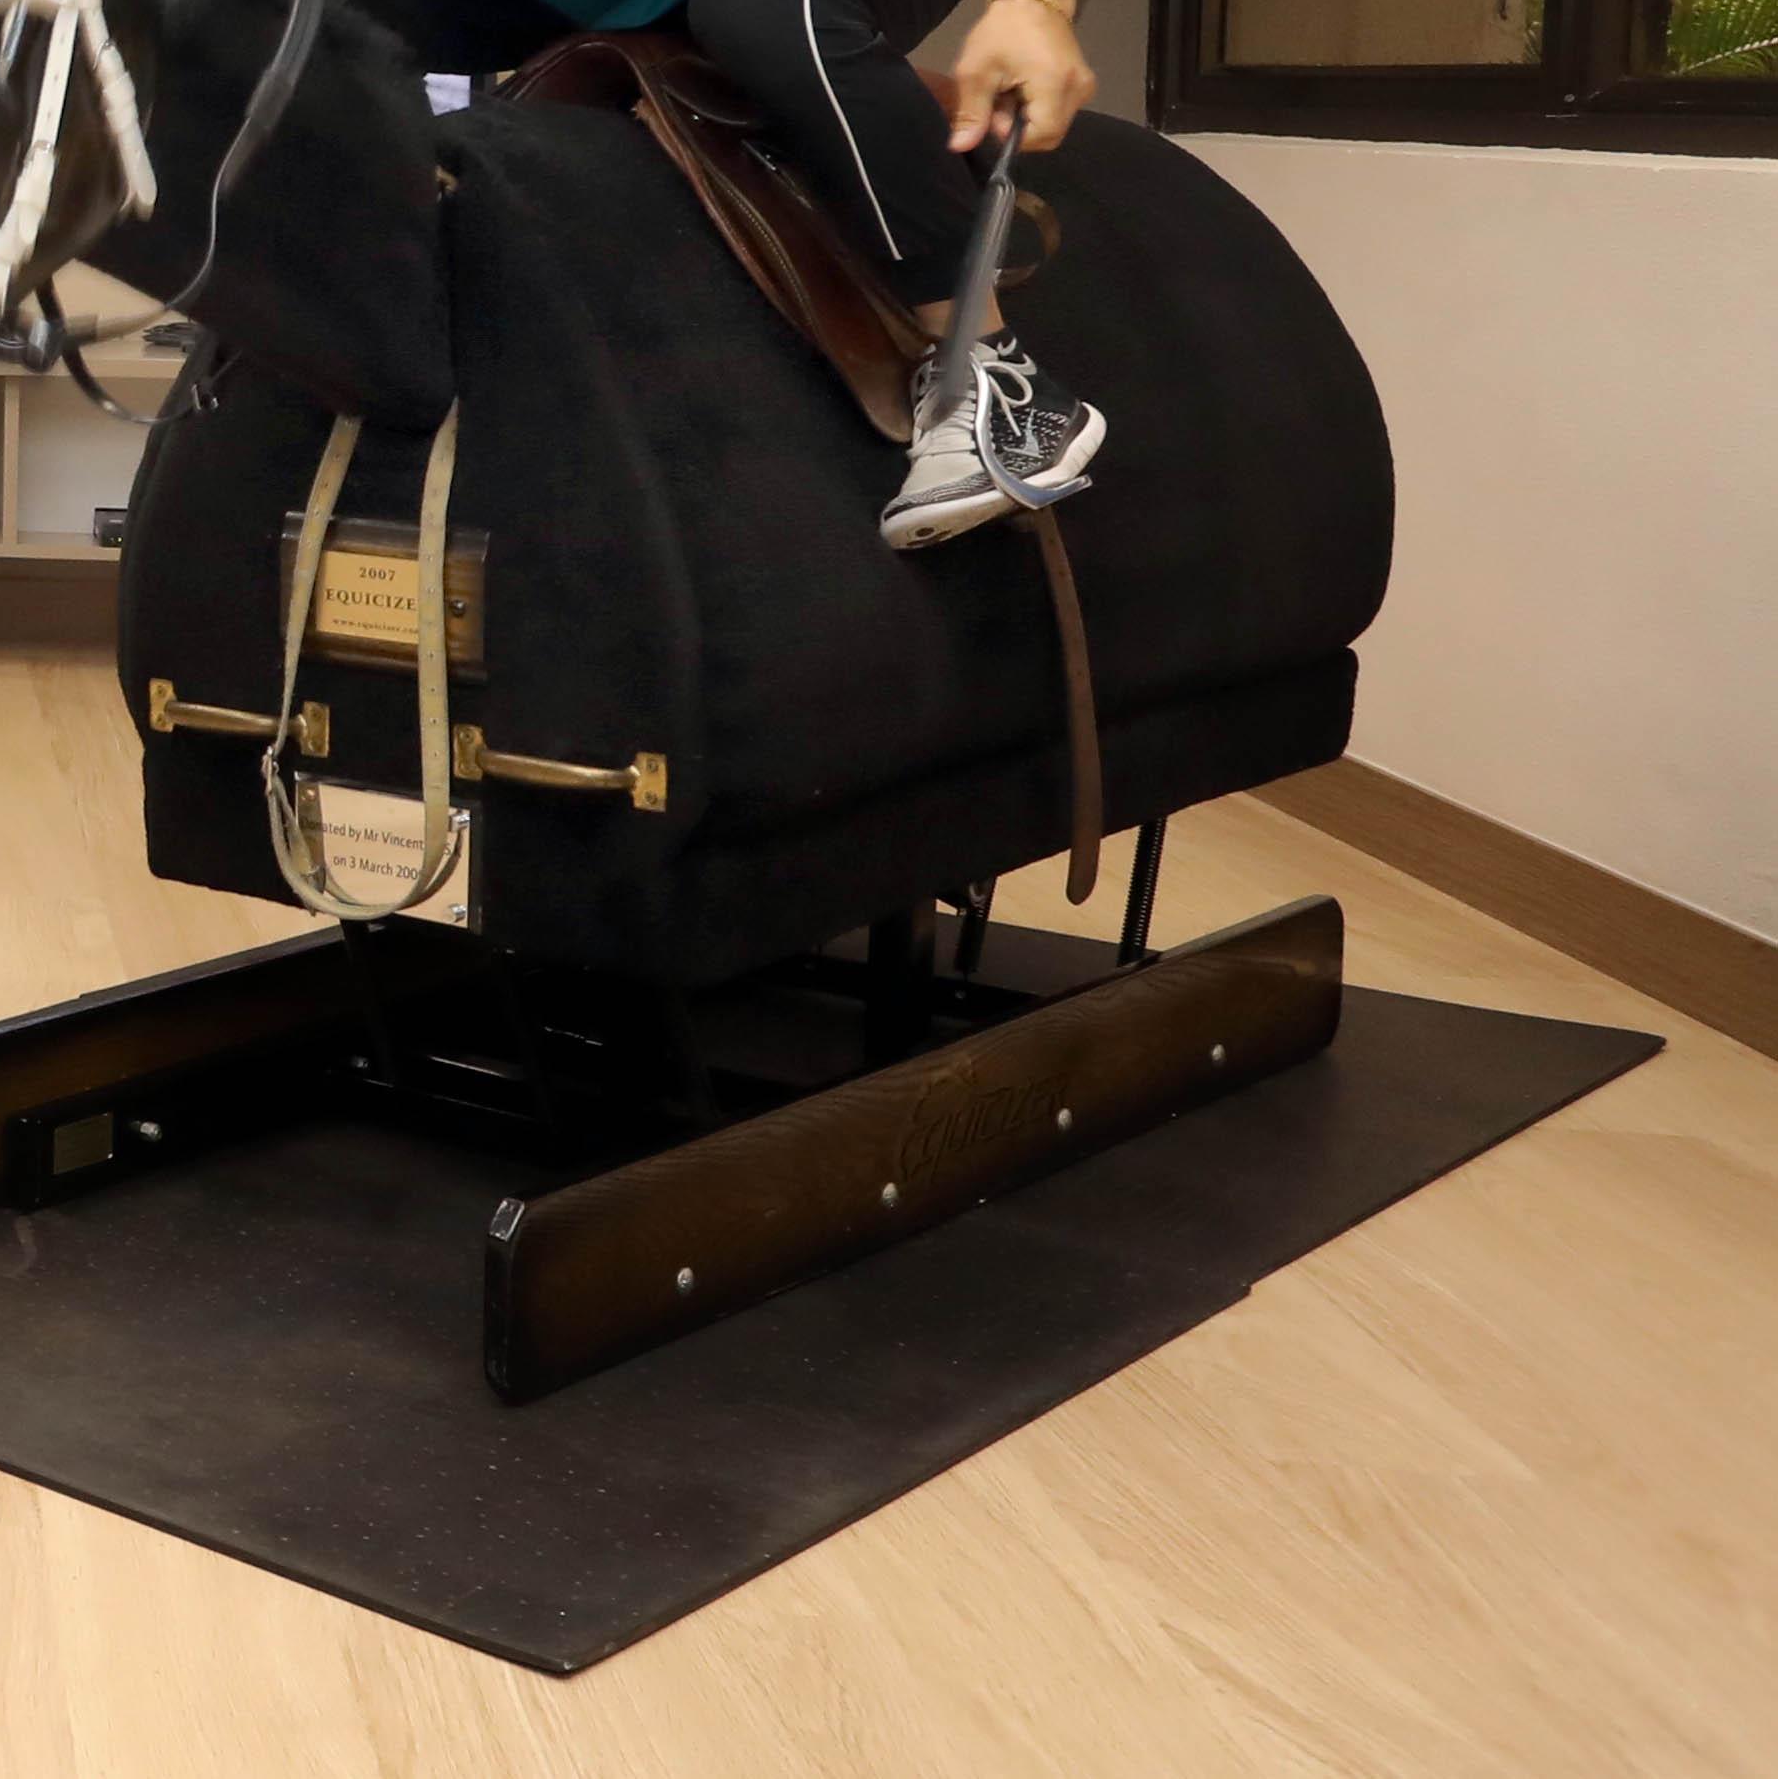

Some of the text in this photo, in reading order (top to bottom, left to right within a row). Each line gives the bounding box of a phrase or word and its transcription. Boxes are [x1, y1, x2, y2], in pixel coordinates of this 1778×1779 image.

[358, 566, 396, 582] 2007
[324, 587, 419, 611] EQUICIZE
[348, 825, 362, 843] by
[363, 828, 379, 841] Mr
[381, 832, 424, 851] Vincent
[333, 856, 420, 881] on 3 March 200
